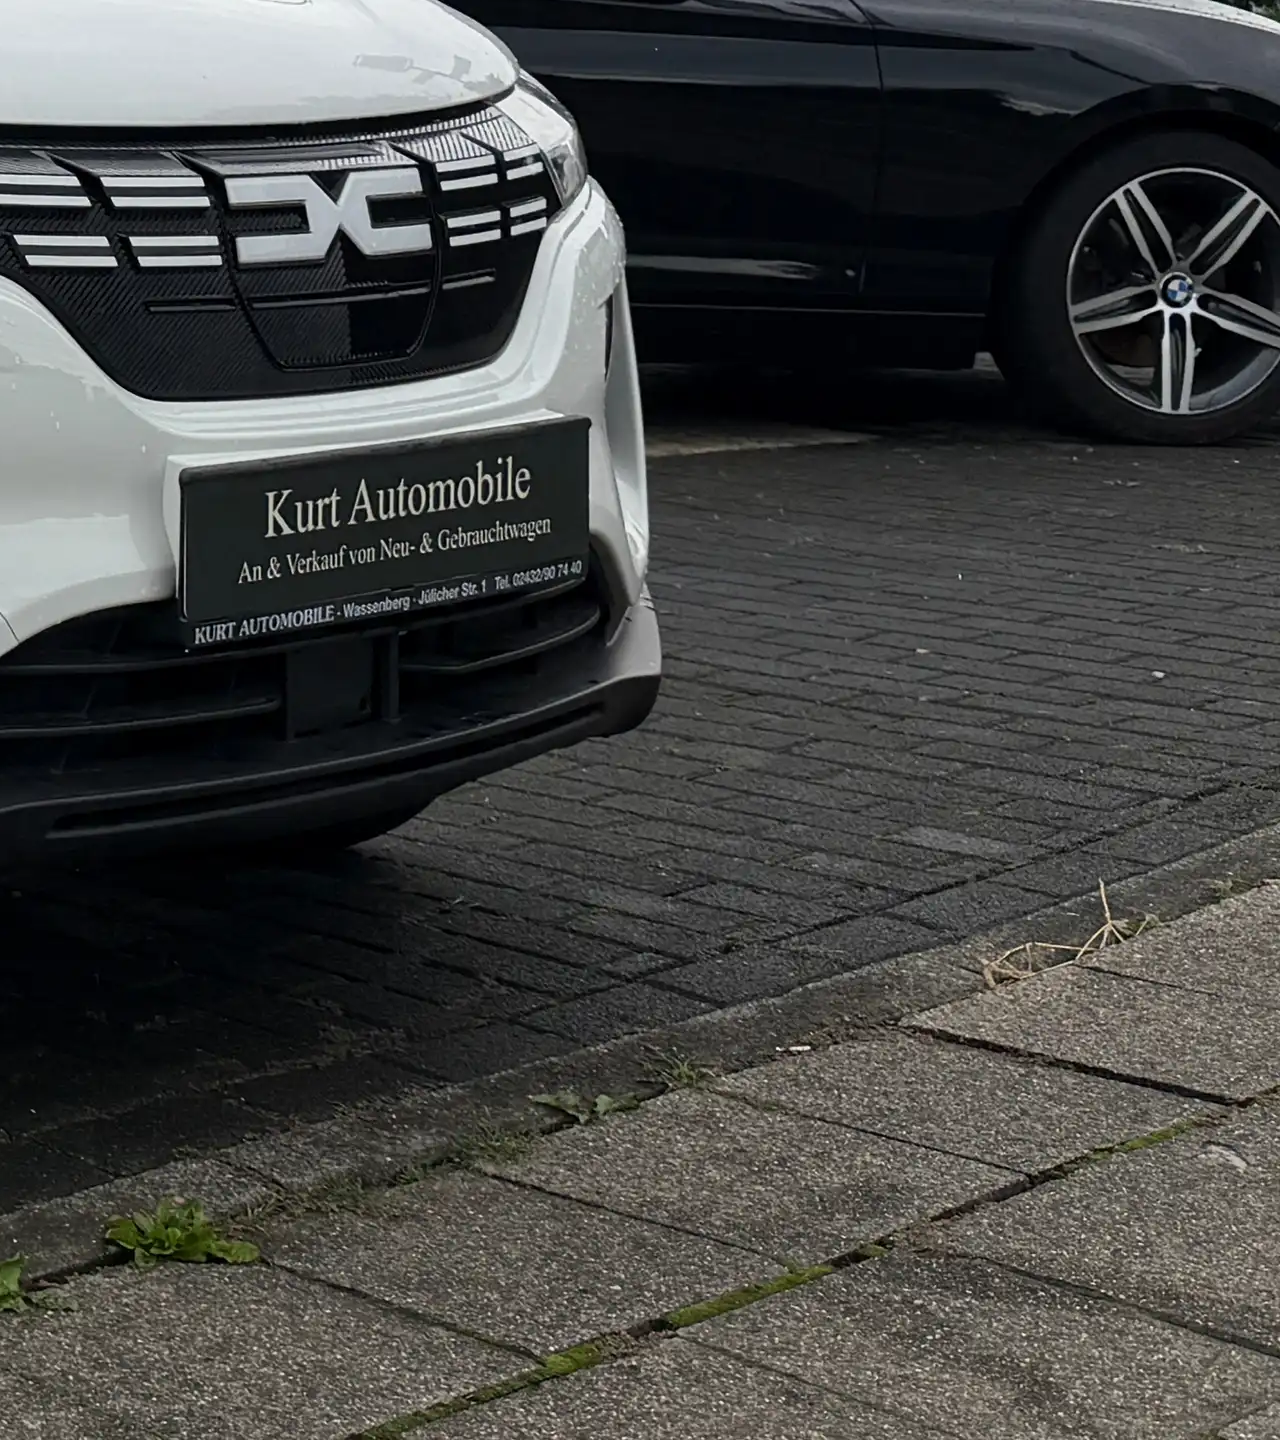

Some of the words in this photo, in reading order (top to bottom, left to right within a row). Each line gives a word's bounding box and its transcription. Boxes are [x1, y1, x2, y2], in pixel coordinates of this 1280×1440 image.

[264, 487, 341, 538] Kurt
[347, 455, 531, 525] Automobile
[238, 561, 262, 584] An
[266, 557, 282, 580] &
[286, 544, 347, 574] Verkauf
[349, 544, 375, 565] von
[379, 537, 416, 560] Neu-
[419, 532, 433, 554] &
[438, 517, 551, 552] Gebrauchtwagen
[194, 622, 236, 645] KURT
[239, 605, 335, 637] AUTOMOBILE
[343, 595, 410, 618] Wassenberg
[418, 587, 459, 605] Jülicher
[461, 581, 479, 597] Str.
[481, 579, 486, 593] 1
[494, 575, 510, 590] Tel.
[512, 566, 556, 587] 02432/90
[557, 563, 568, 578] 74
[570, 560, 582, 574] 40
